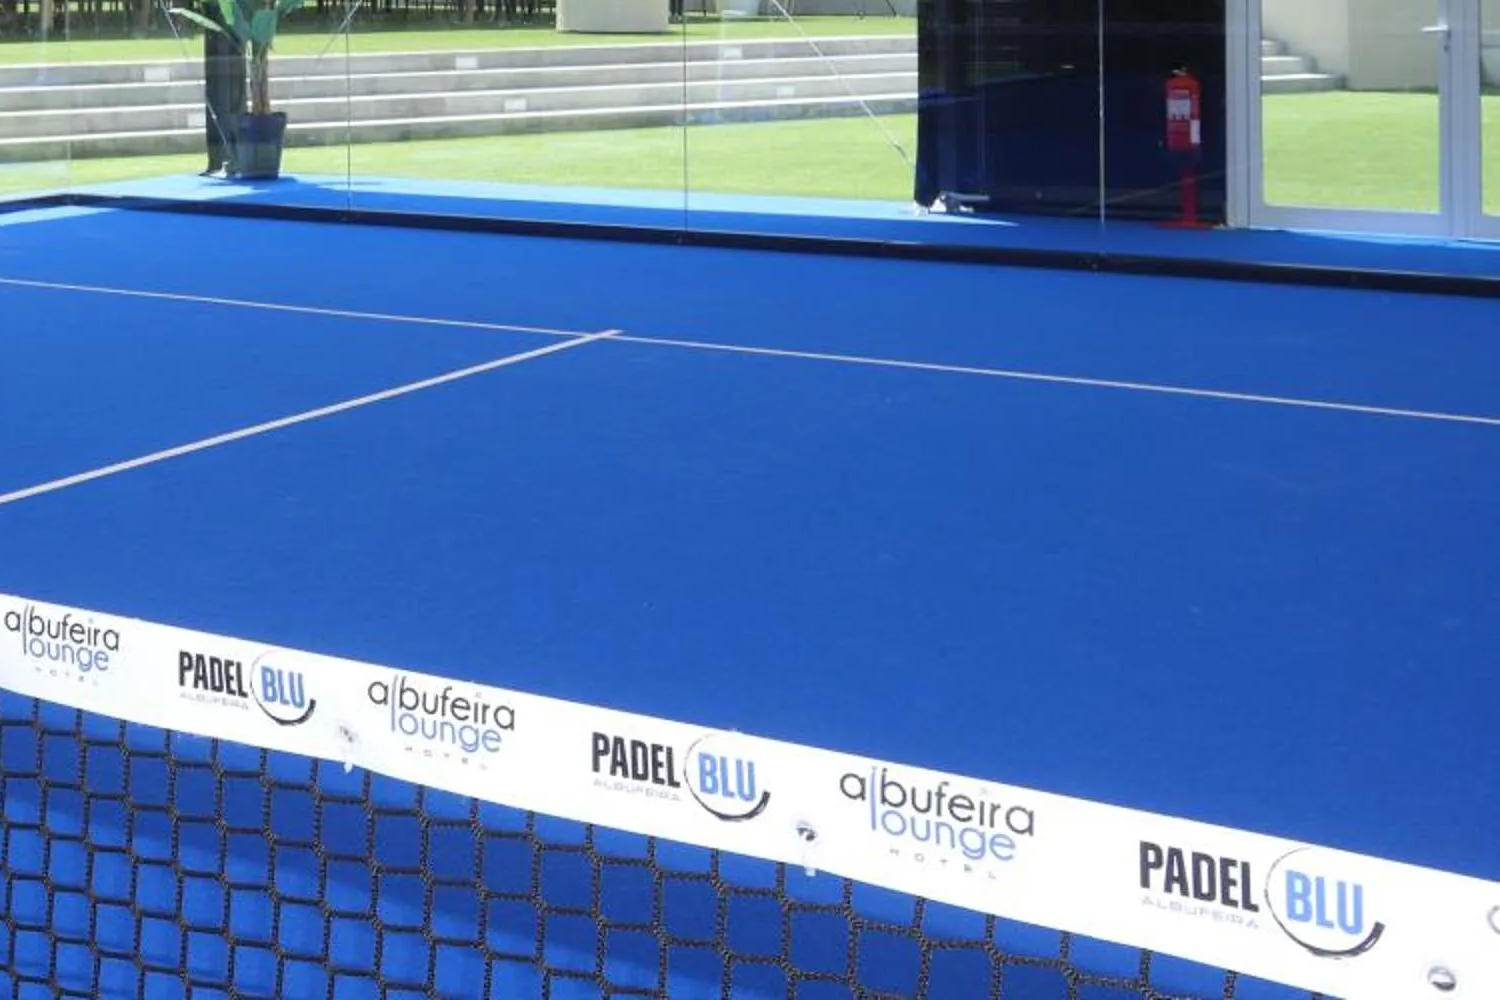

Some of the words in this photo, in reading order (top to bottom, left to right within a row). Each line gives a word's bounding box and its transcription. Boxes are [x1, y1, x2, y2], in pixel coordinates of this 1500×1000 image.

[4, 603, 120, 651] albufeira
[22, 627, 110, 672] lounge
[179, 650, 249, 699] PADEL
[260, 665, 306, 709] BLU
[367, 675, 515, 731] albufeira
[390, 702, 502, 753] lounge
[591, 731, 681, 789] PADEL
[697, 751, 757, 803] BLU
[839, 766, 1035, 837] albufeira
[870, 794, 1016, 861] lounge
[1139, 840, 1260, 913] PADEL
[1285, 869, 1364, 936] BLU
